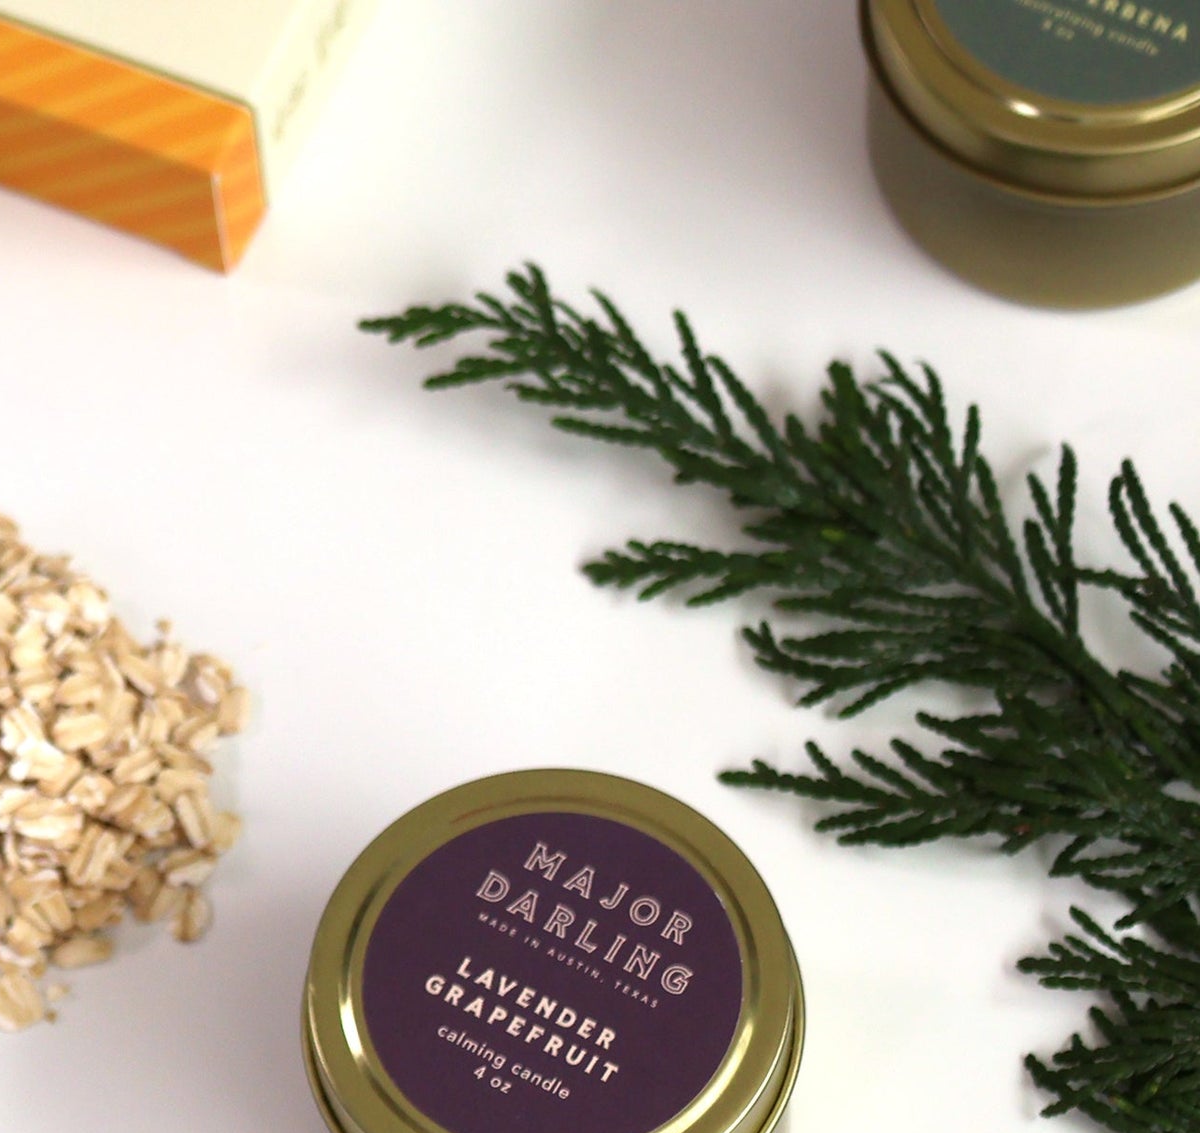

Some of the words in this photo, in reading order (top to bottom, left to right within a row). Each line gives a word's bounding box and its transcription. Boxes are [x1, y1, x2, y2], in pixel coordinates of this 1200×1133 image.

[476, 869, 694, 995] DARLING
[523, 841, 694, 946] MAJOR
[456, 956, 617, 1050] LAVENDER
[478, 911, 517, 938] MADE
[523, 934, 541, 949] IN
[547, 948, 604, 984] AUSTIN,
[614, 980, 659, 1009] TEXAS
[424, 974, 619, 1084] GRAPEFRUIT
[437, 1024, 506, 1071] calming
[511, 1061, 570, 1100] candle
[473, 1064, 484, 1081] 4
[490, 1075, 513, 1094] oz
